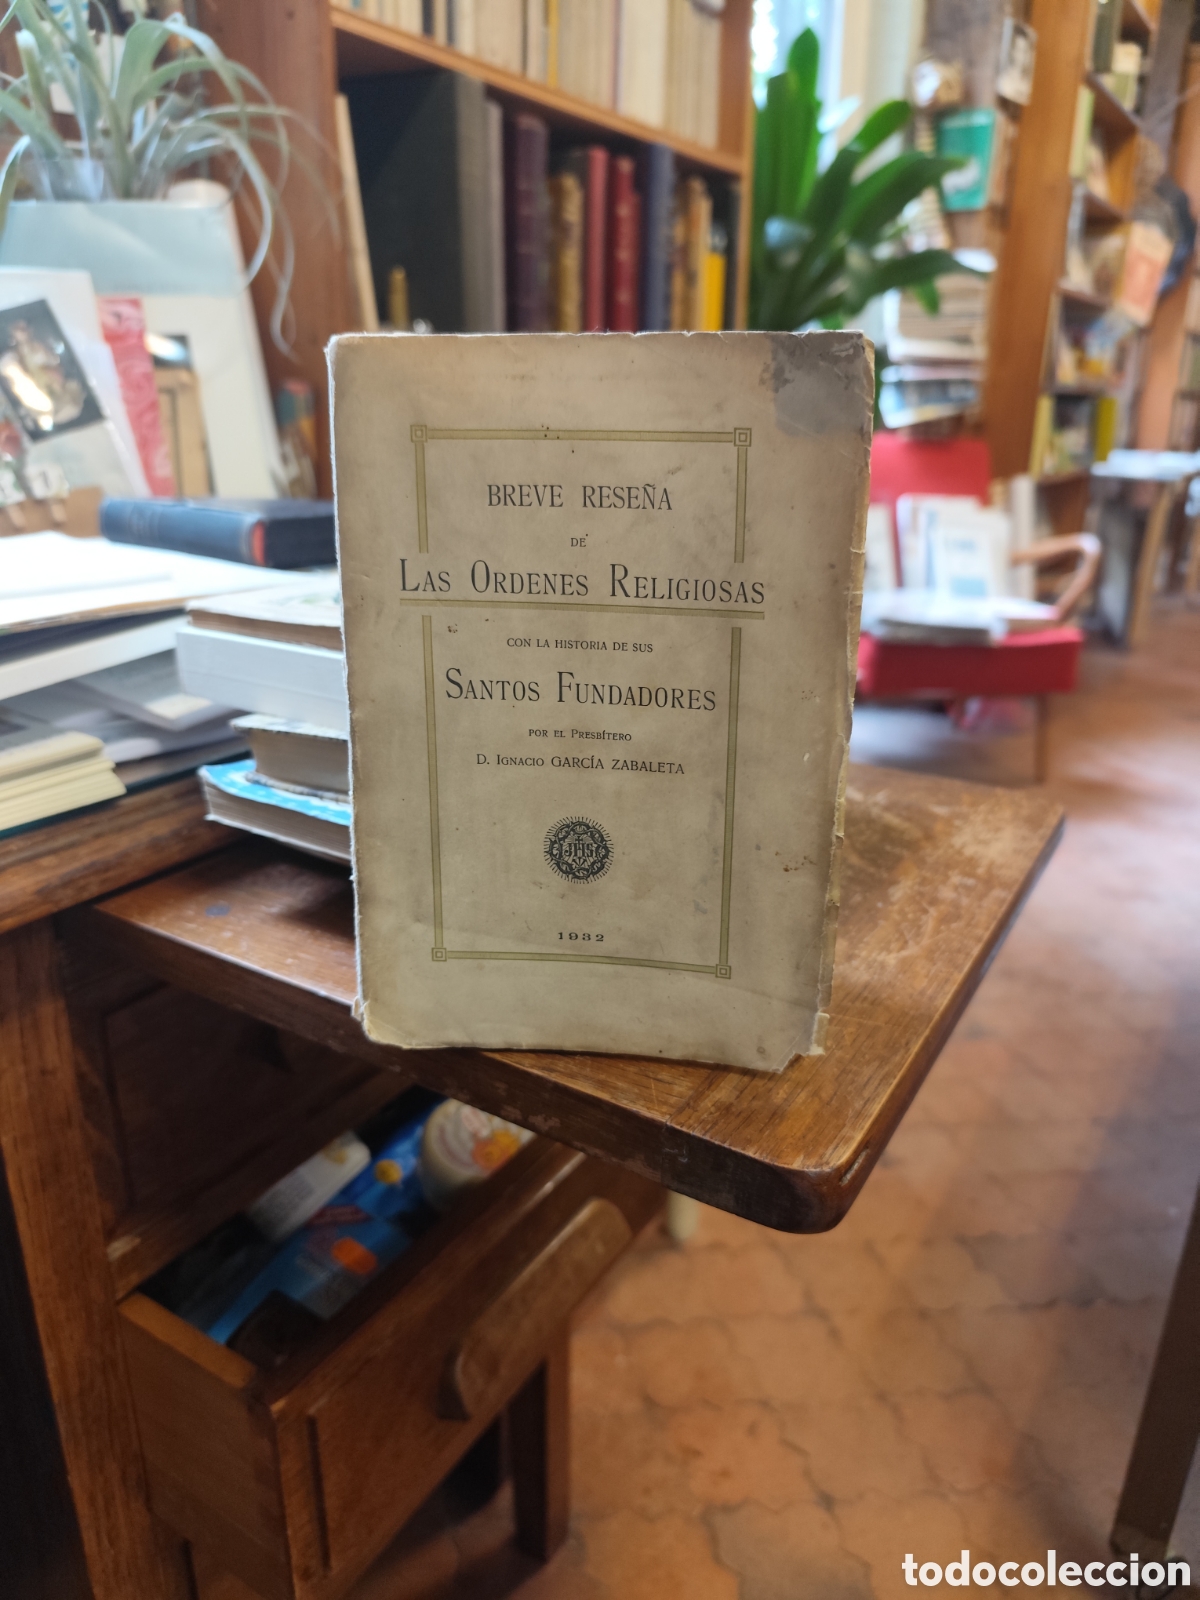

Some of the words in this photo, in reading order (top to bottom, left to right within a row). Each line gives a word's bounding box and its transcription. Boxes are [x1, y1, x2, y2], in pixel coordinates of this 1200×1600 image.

[487, 484, 563, 508] BREVE
[582, 483, 673, 511] RESEÑA
[570, 537, 587, 548] DE
[506, 637, 532, 648] CON
[536, 638, 551, 649] LA
[554, 639, 608, 651] HISTORIA
[612, 641, 629, 652] DE
[632, 642, 654, 653] SUS
[528, 728, 549, 738] POR
[553, 729, 566, 738] EL
[476, 753, 490, 765] D.
[551, 754, 605, 770] GARCÍA
[611, 758, 685, 775] ZABALETA
[557, 931, 605, 942] 1932
